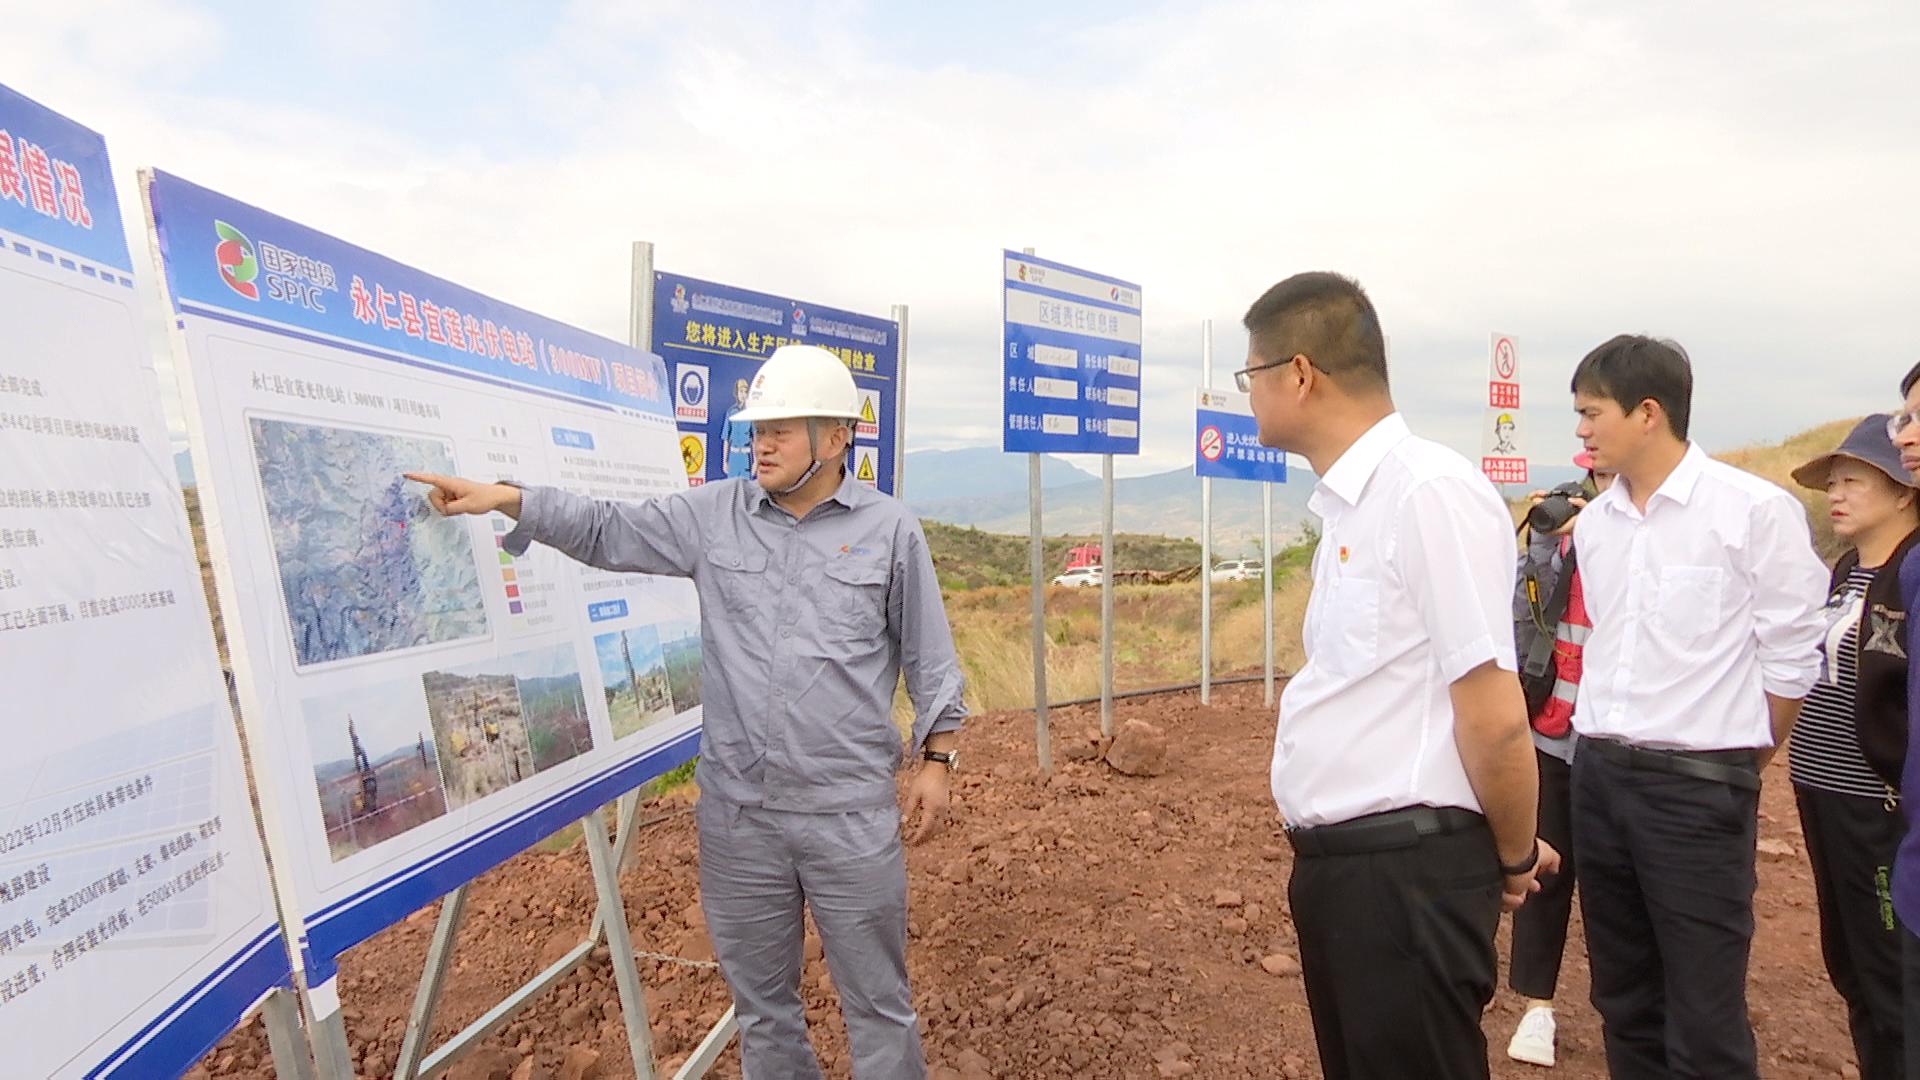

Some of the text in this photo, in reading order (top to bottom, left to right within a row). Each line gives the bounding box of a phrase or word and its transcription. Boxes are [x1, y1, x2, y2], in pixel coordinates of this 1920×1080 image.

[0, 129, 93, 230] 展情况
[258, 241, 338, 292] 国家电投
[266, 273, 326, 313] SPIC
